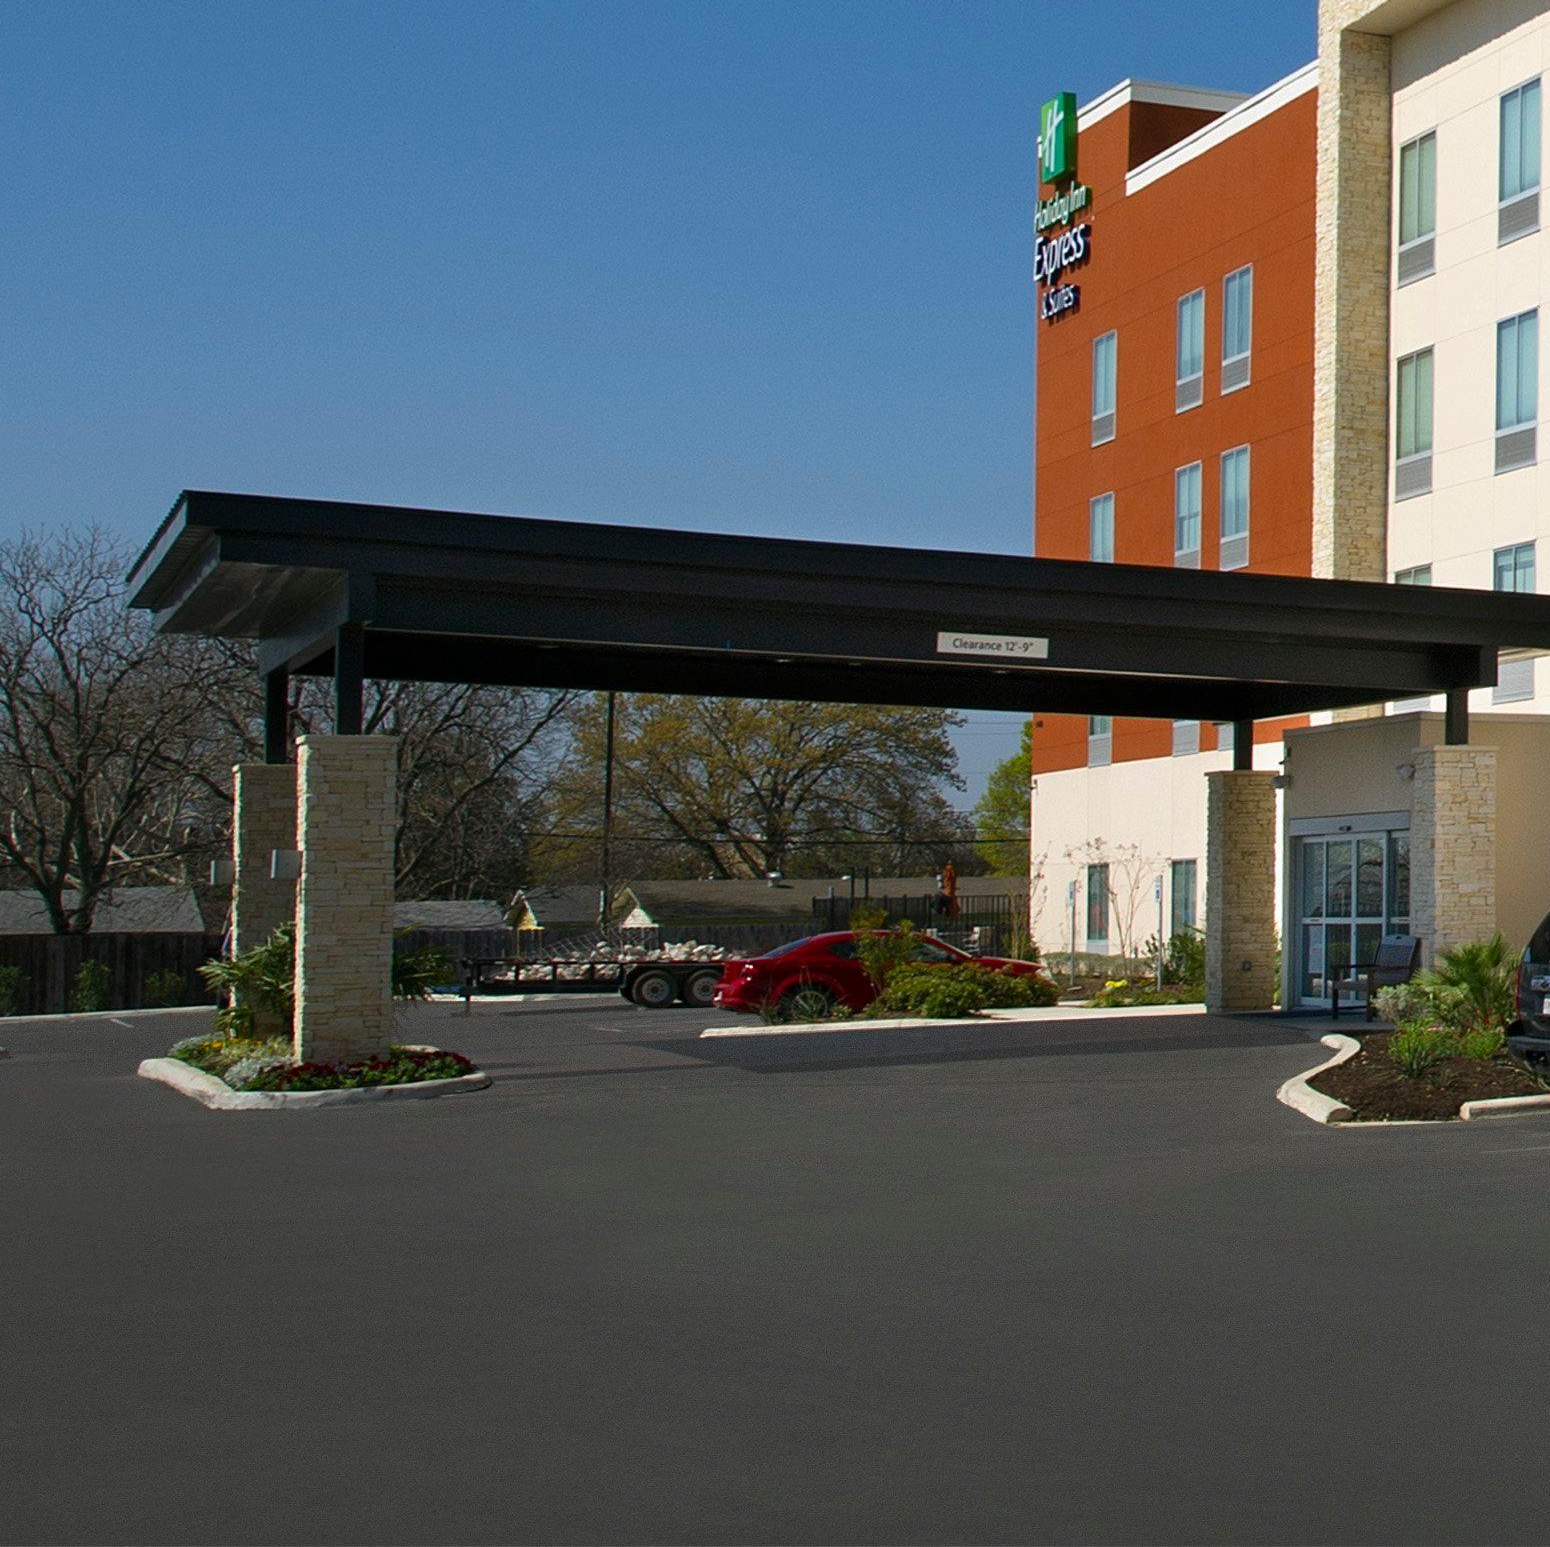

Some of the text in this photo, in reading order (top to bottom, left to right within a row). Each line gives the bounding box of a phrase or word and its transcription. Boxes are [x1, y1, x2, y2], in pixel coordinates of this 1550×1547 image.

[1034, 191, 1070, 234] Holiday
[1033, 223, 1086, 285] Express
[1048, 284, 1075, 316] Suites
[952, 637, 1003, 651] Clearance
